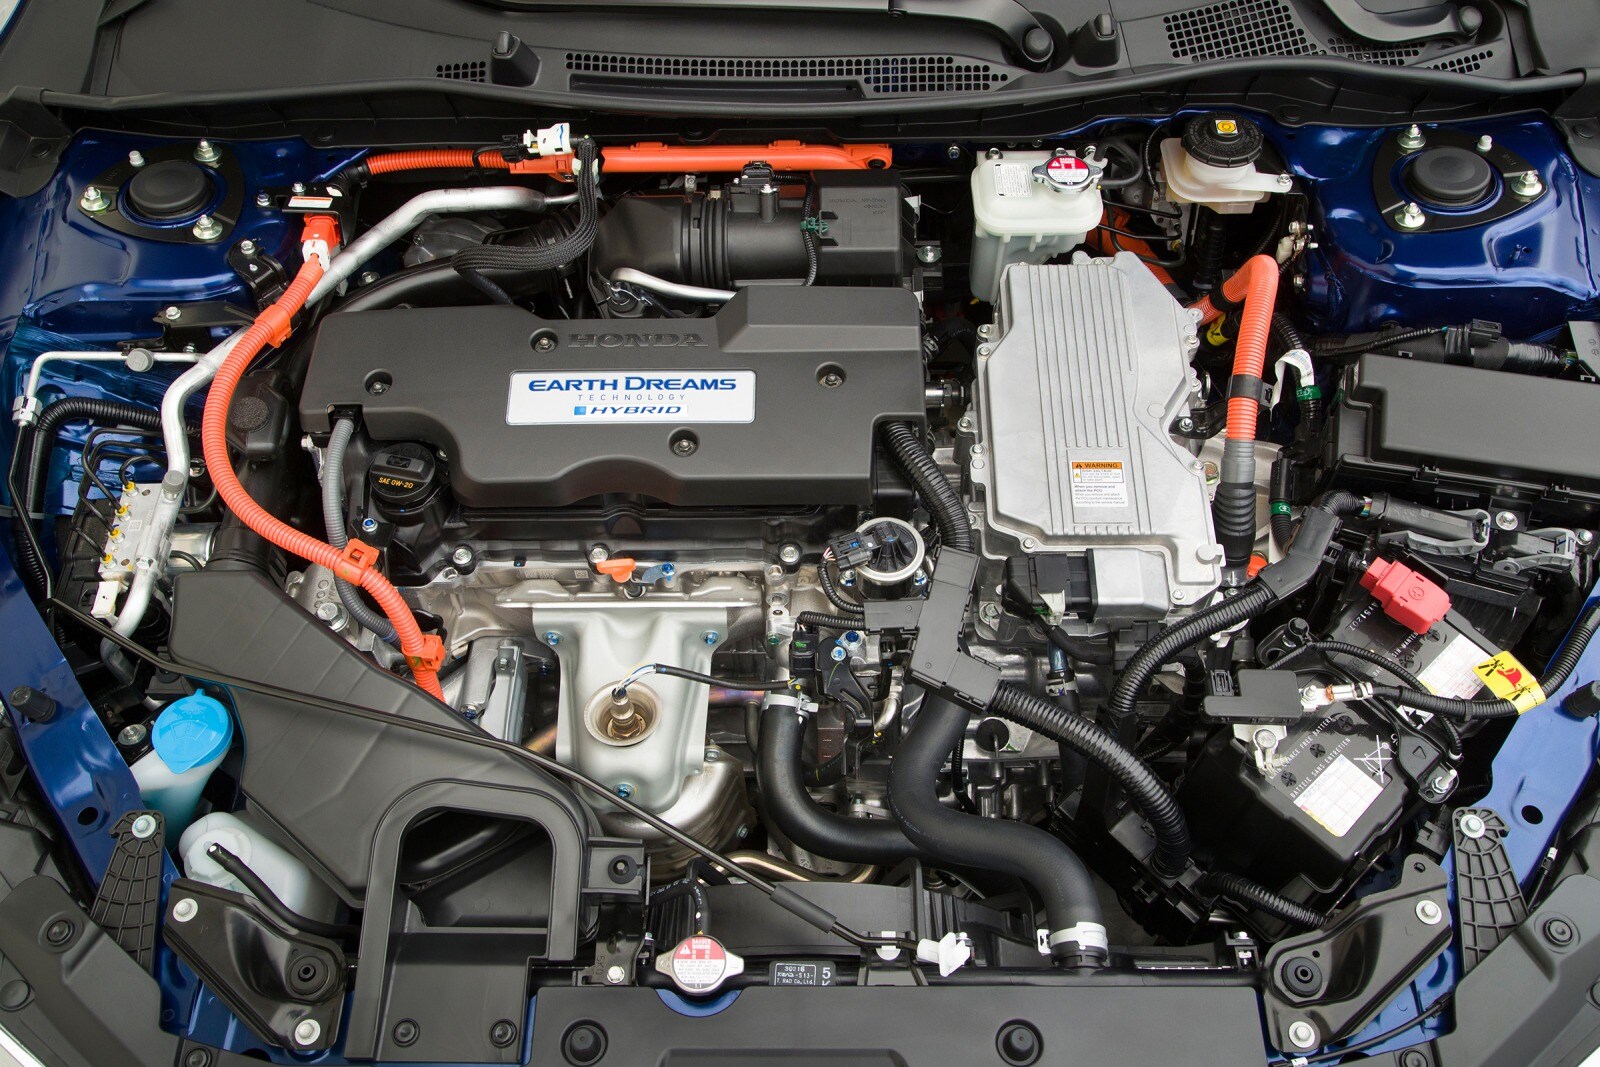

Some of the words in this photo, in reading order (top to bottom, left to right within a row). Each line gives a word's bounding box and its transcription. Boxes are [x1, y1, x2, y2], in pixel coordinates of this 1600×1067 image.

[568, 333, 708, 348] HONDA
[528, 379, 618, 392] EARTH
[625, 376, 736, 390] DREAMS
[590, 406, 682, 415] HYBRID
[1300, 736, 1314, 749] FREE
[1312, 764, 1325, 777] SANS
[1324, 738, 1350, 764] ENTRETIEN
